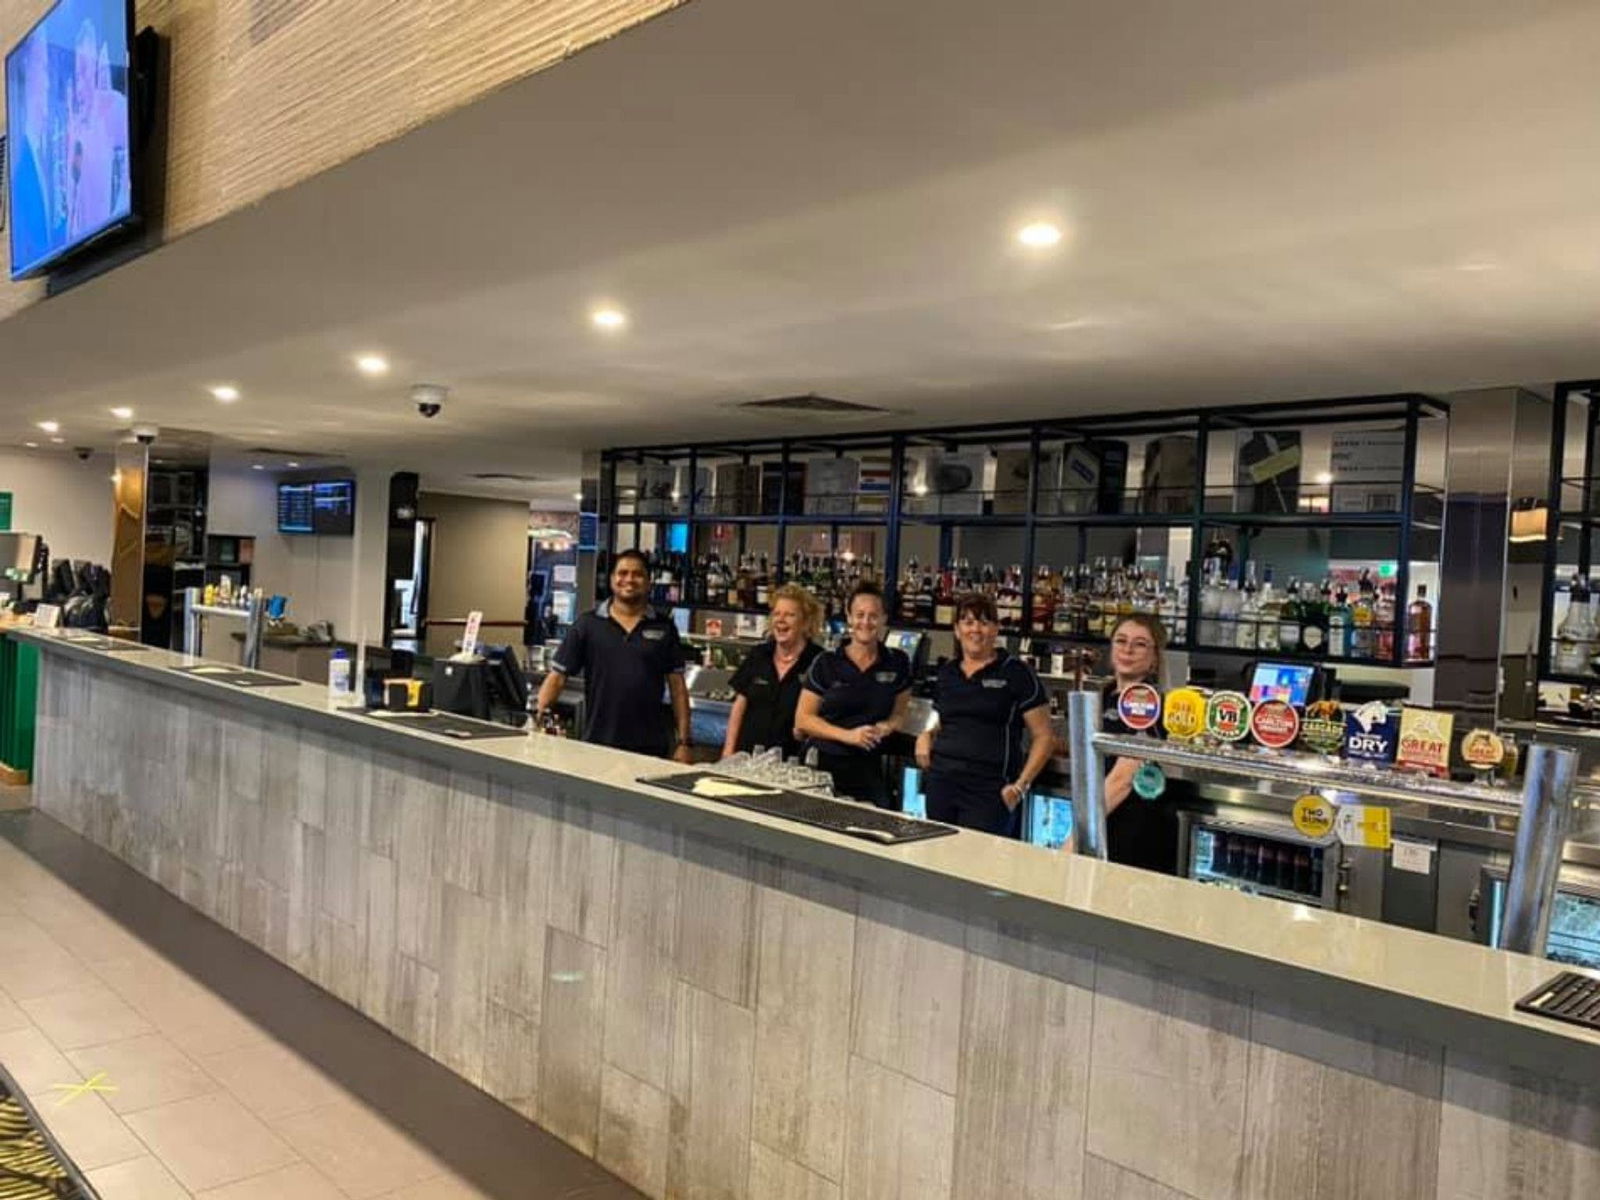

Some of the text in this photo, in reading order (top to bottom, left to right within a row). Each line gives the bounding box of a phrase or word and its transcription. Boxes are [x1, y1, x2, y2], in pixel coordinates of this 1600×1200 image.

[1219, 708, 1237, 723] VB
[1349, 736, 1388, 753] DRY
[1402, 739, 1445, 754] GREAT
